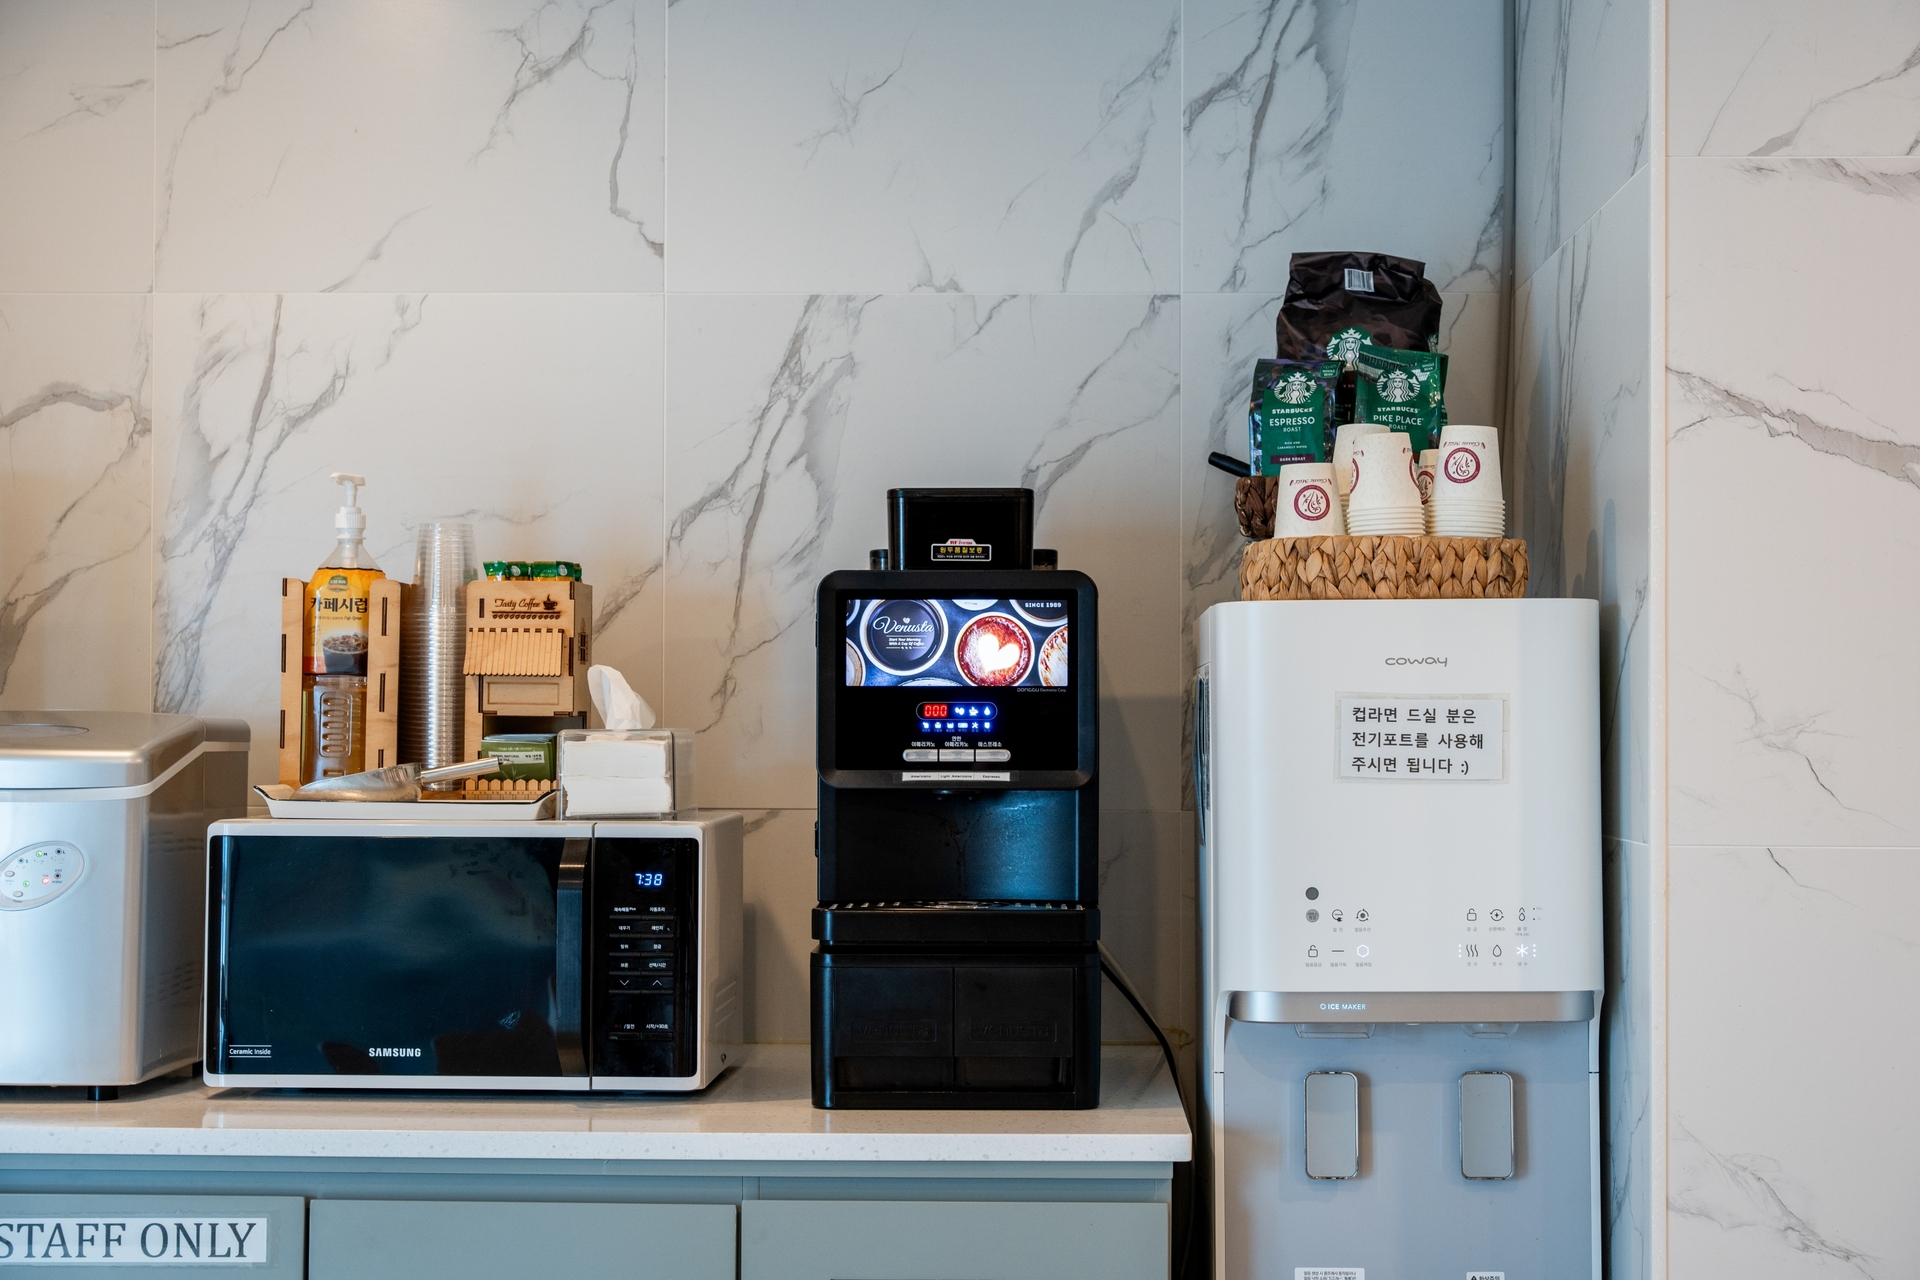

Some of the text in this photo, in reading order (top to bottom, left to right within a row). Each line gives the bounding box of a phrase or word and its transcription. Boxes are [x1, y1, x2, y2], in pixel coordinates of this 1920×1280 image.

[1270, 416, 1315, 426] ESPRESSO
[1373, 414, 1422, 426] PIKE PLACE
[311, 598, 368, 613] 카페시럽
[494, 598, 540, 610] Tasty Coffee
[873, 616, 934, 634] Venusta
[1385, 656, 1447, 667] coway
[1352, 707, 1476, 724] 컵라면 드실 분은
[1352, 732, 1484, 749] 전기포트를 사용해
[1352, 757, 1469, 775] 주시면 됩니다 :)
[635, 873, 663, 885] 7:38
[369, 1047, 421, 1057] SAMSUNG
[0, 1222, 256, 1258] STAFF ONLY
